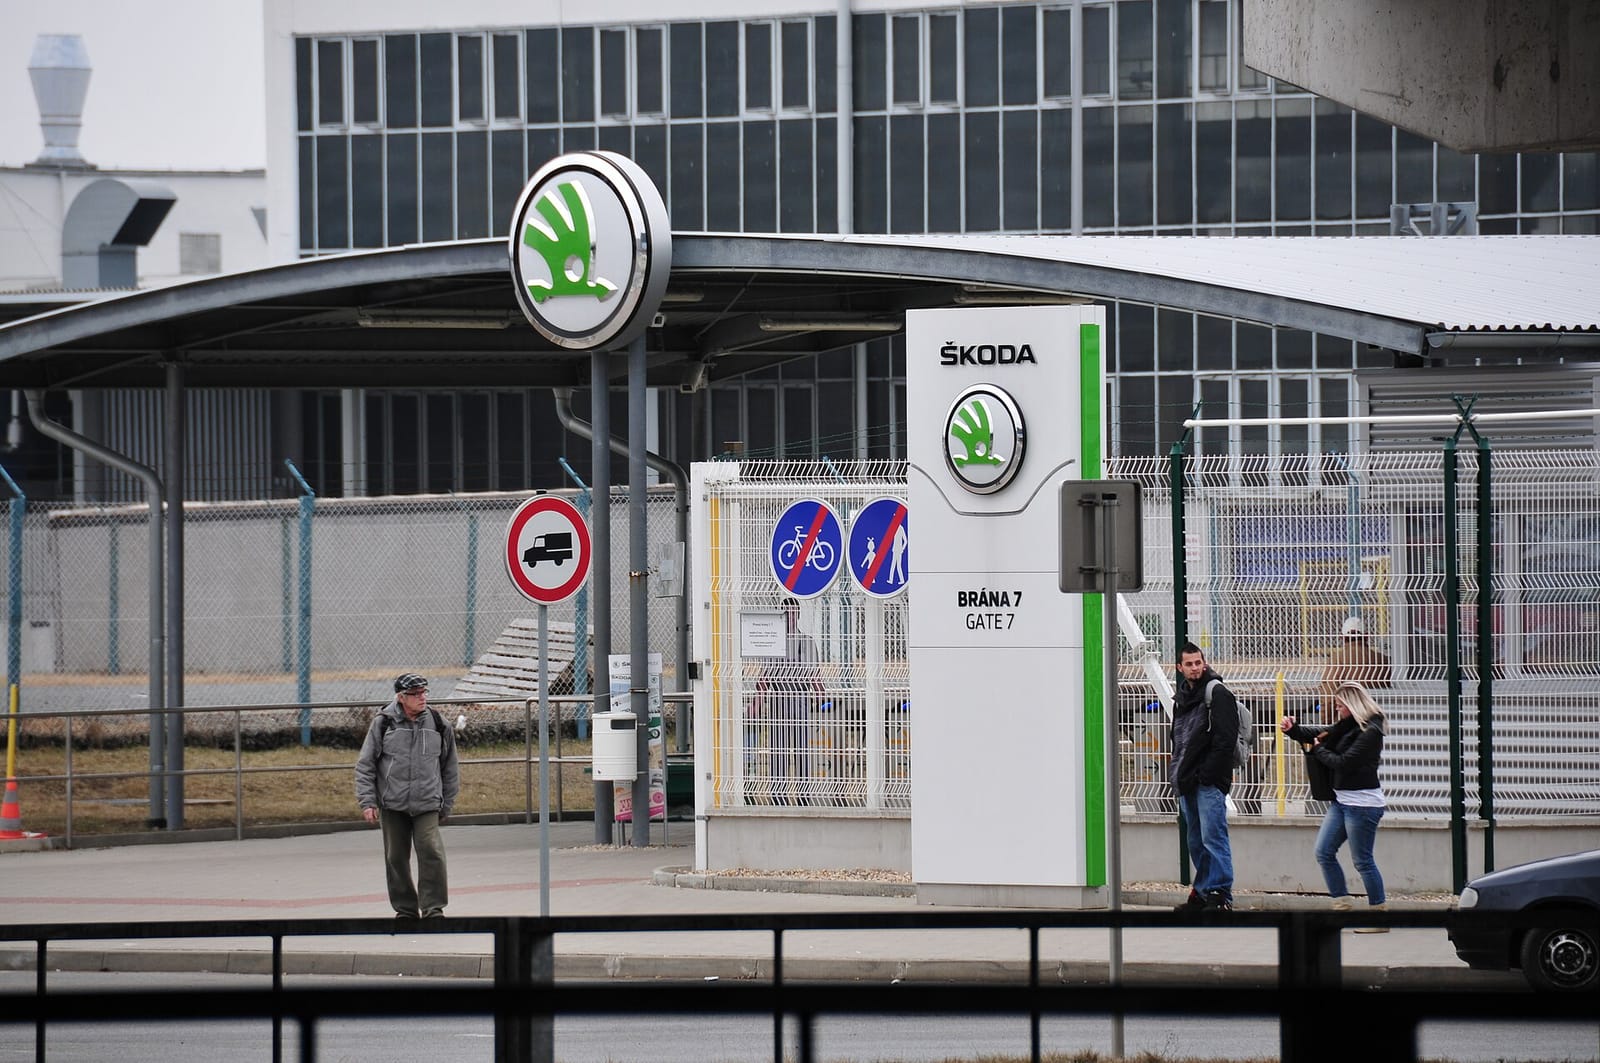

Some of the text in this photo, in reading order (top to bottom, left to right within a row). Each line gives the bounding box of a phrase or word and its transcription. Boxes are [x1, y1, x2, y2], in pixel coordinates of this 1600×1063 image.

[940, 341, 1036, 366] ŠKODA
[958, 587, 1022, 607] BRÁNA 7
[966, 613, 1015, 630] GATE 7
